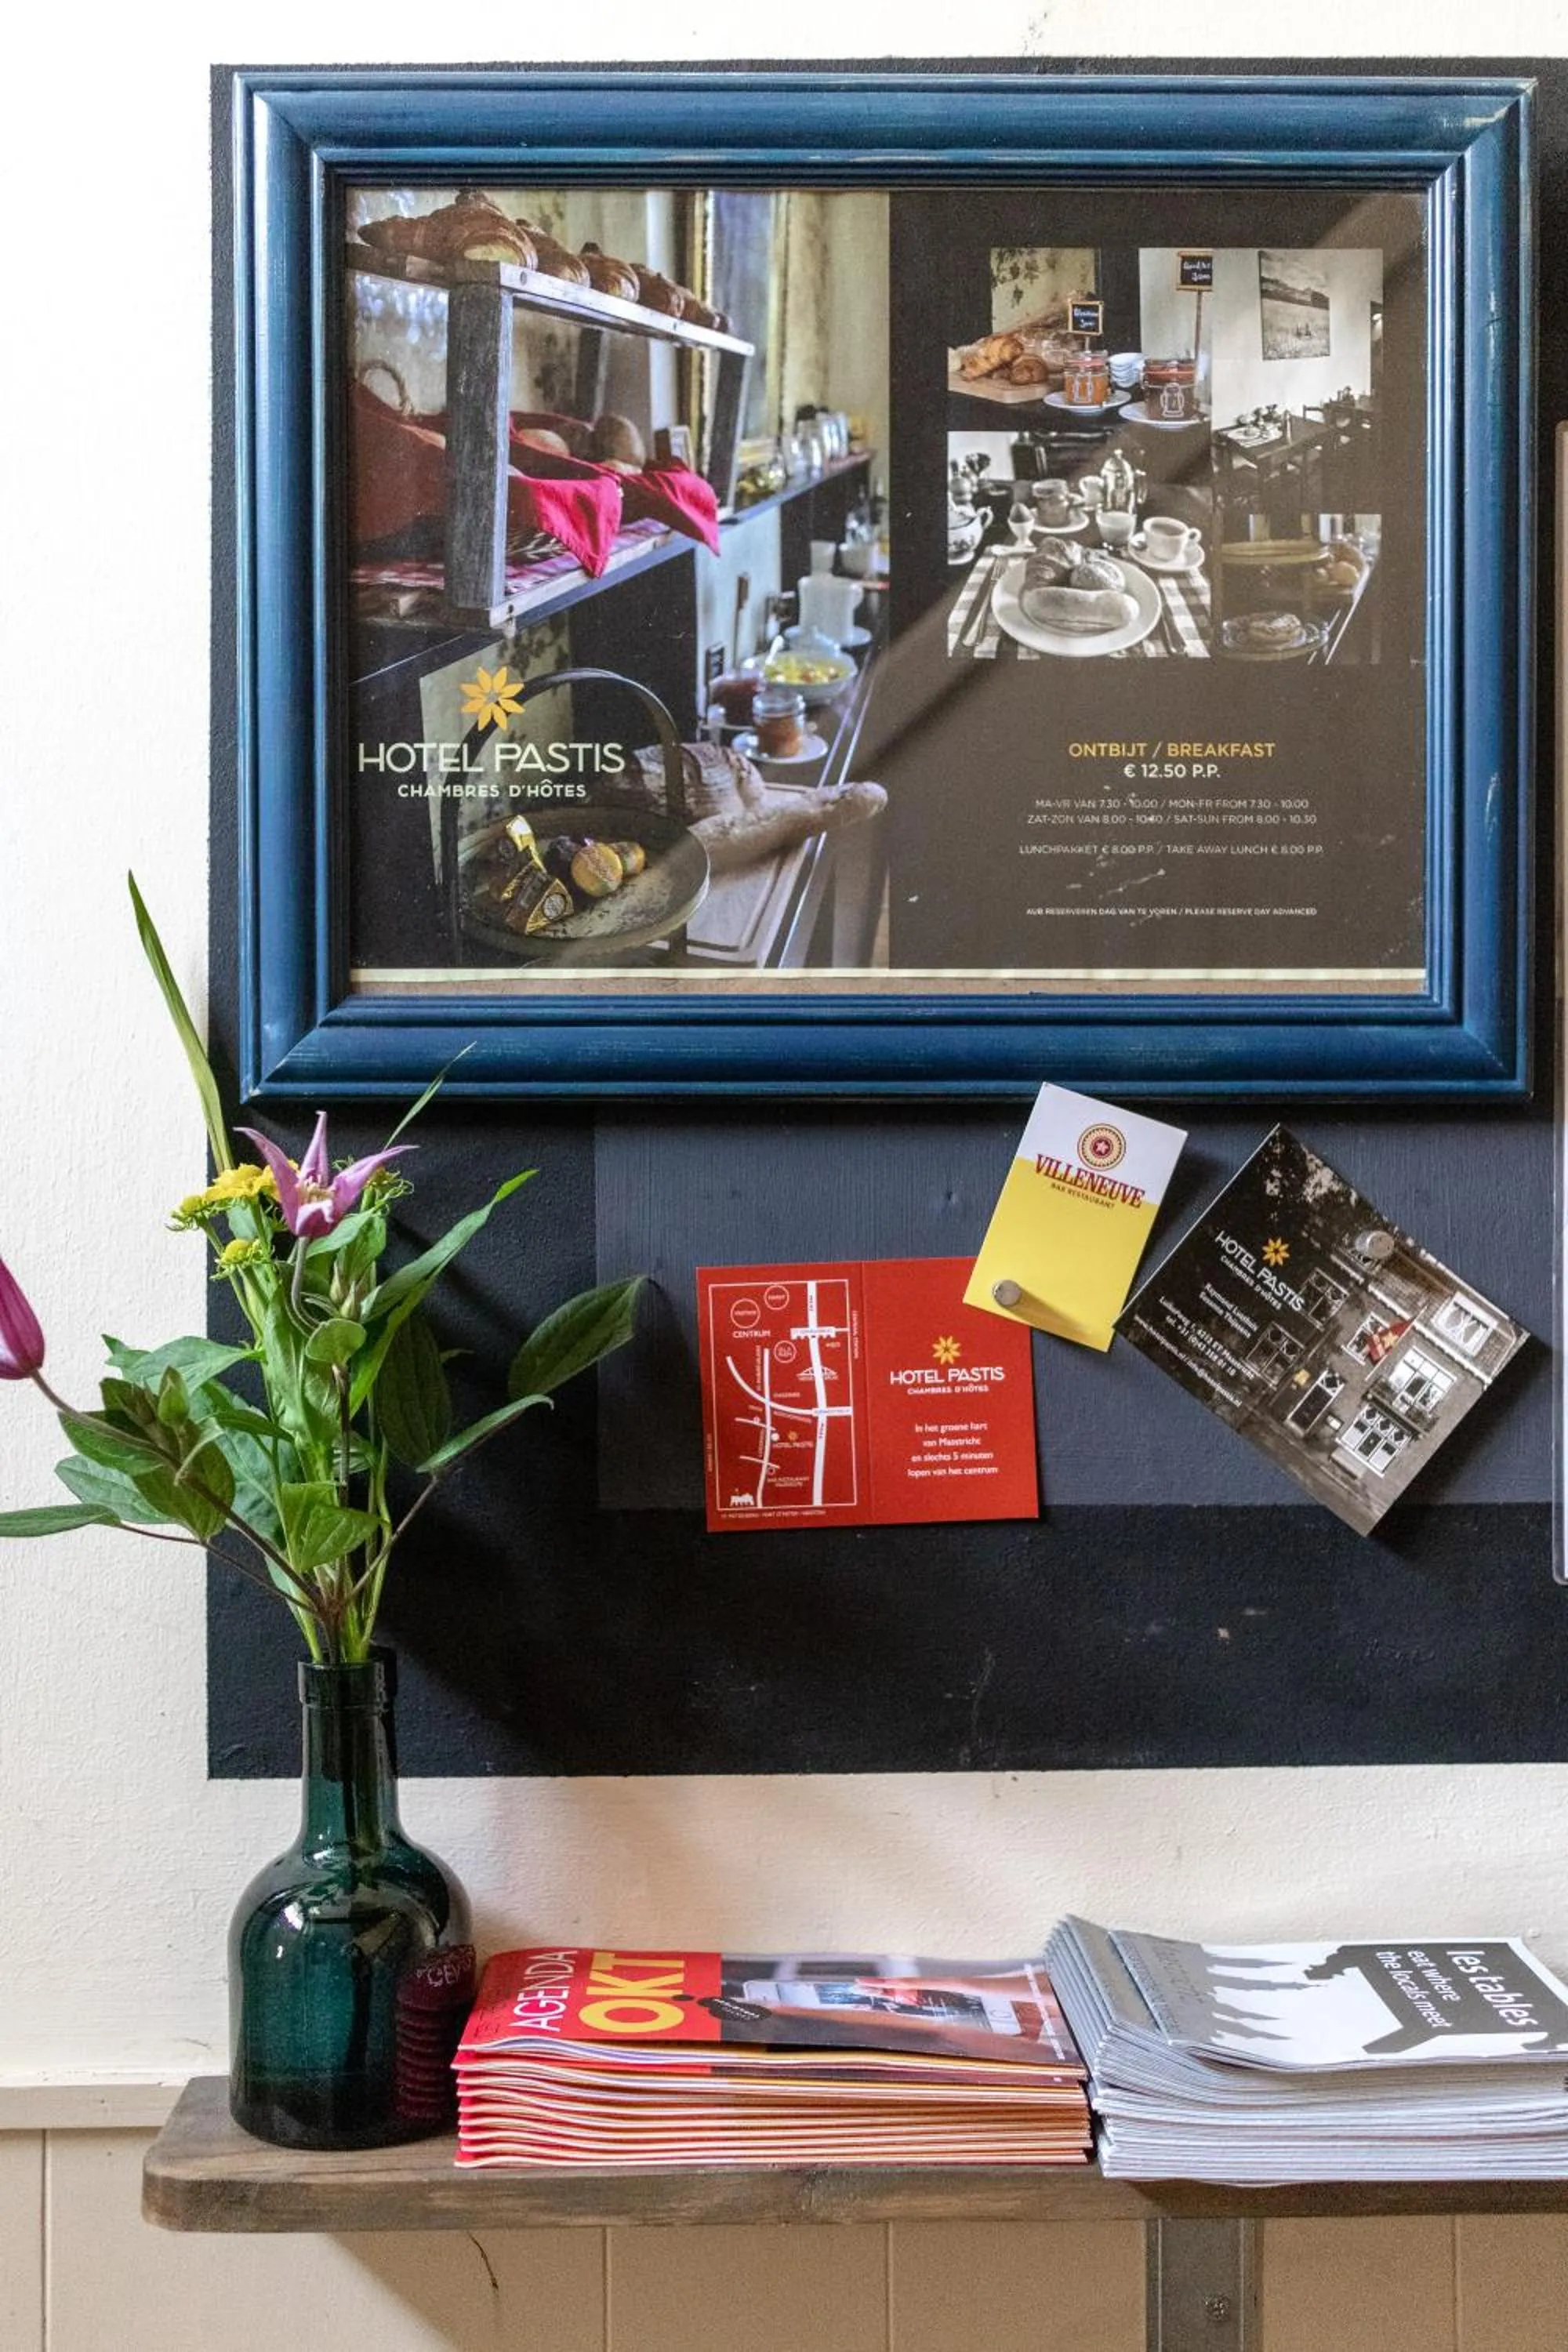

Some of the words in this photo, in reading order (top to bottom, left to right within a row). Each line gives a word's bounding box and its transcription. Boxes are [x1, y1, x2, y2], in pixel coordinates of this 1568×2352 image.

[358, 742, 484, 773] HOTEL
[495, 742, 626, 774] PASTIS
[1069, 742, 1148, 758] ONTBIJT
[1152, 741, 1163, 759] /
[1167, 742, 1276, 758] BREAKFAST
[1123, 764, 1136, 779] €
[1142, 764, 1186, 779] 12.50
[1192, 764, 1221, 779] P.P.
[397, 784, 499, 798] CHAMBRES
[509, 779, 587, 798] D'HÔTES
[1073, 799, 1097, 809] VAN
[1169, 798, 1214, 809] MON-FR
[1216, 798, 1247, 809] FROM
[1077, 814, 1100, 825] VAN
[1174, 814, 1219, 825] SAT-SUN
[1221, 814, 1254, 825] FROM
[1166, 844, 1193, 854] TAKE
[1196, 844, 1227, 855] AWAY
[1230, 844, 1268, 855] LUNCH
[1034, 1153, 1145, 1209] VILLENEUVE
[1215, 1231, 1255, 1273] HOTEL
[1257, 1267, 1305, 1311] PASTIS
[890, 1369, 945, 1385] HOTEL
[948, 1367, 1005, 1382] PASTIS
[1407, 1950, 1436, 1968] eat
[508, 1950, 579, 2033] AGENDA
[578, 1951, 686, 2034] OKT
[1376, 1951, 1402, 1969] the
[1389, 1970, 1431, 2001] locals
[1414, 2001, 1453, 2028] meet
[1421, 1969, 1461, 2002] where
[1446, 1951, 1489, 1974] les
[1468, 1976, 1539, 2027] tables
